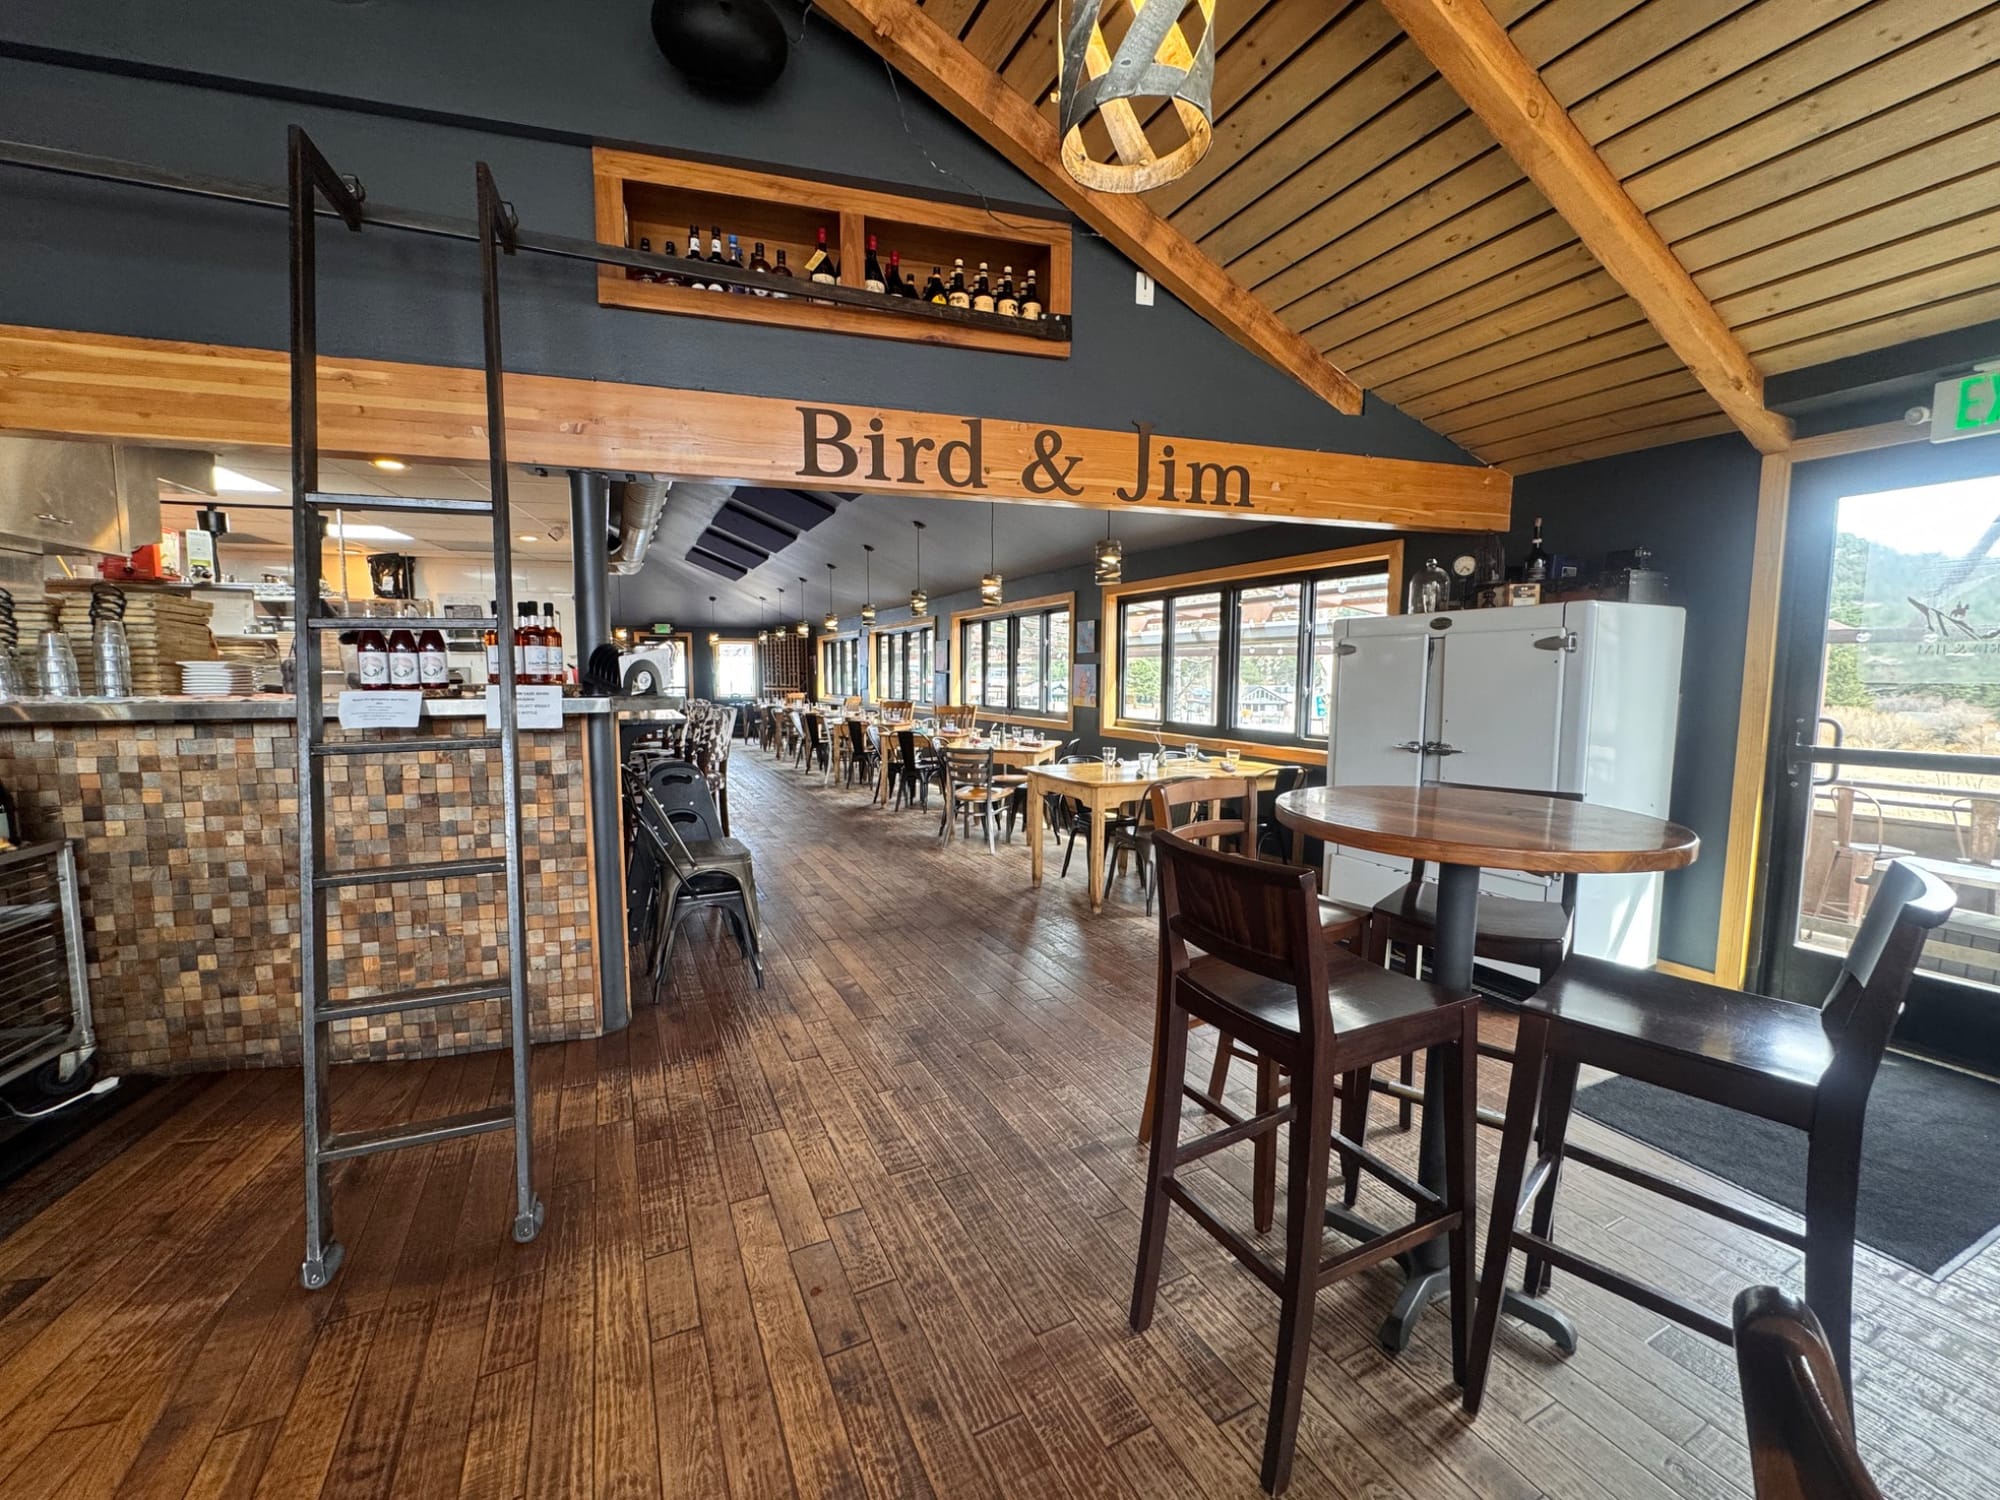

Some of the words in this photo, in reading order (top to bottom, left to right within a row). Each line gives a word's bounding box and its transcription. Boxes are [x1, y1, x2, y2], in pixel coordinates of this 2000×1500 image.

[795, 406, 988, 489] Bird
[1021, 429, 1085, 497] &
[1116, 419, 1256, 508] Jim
